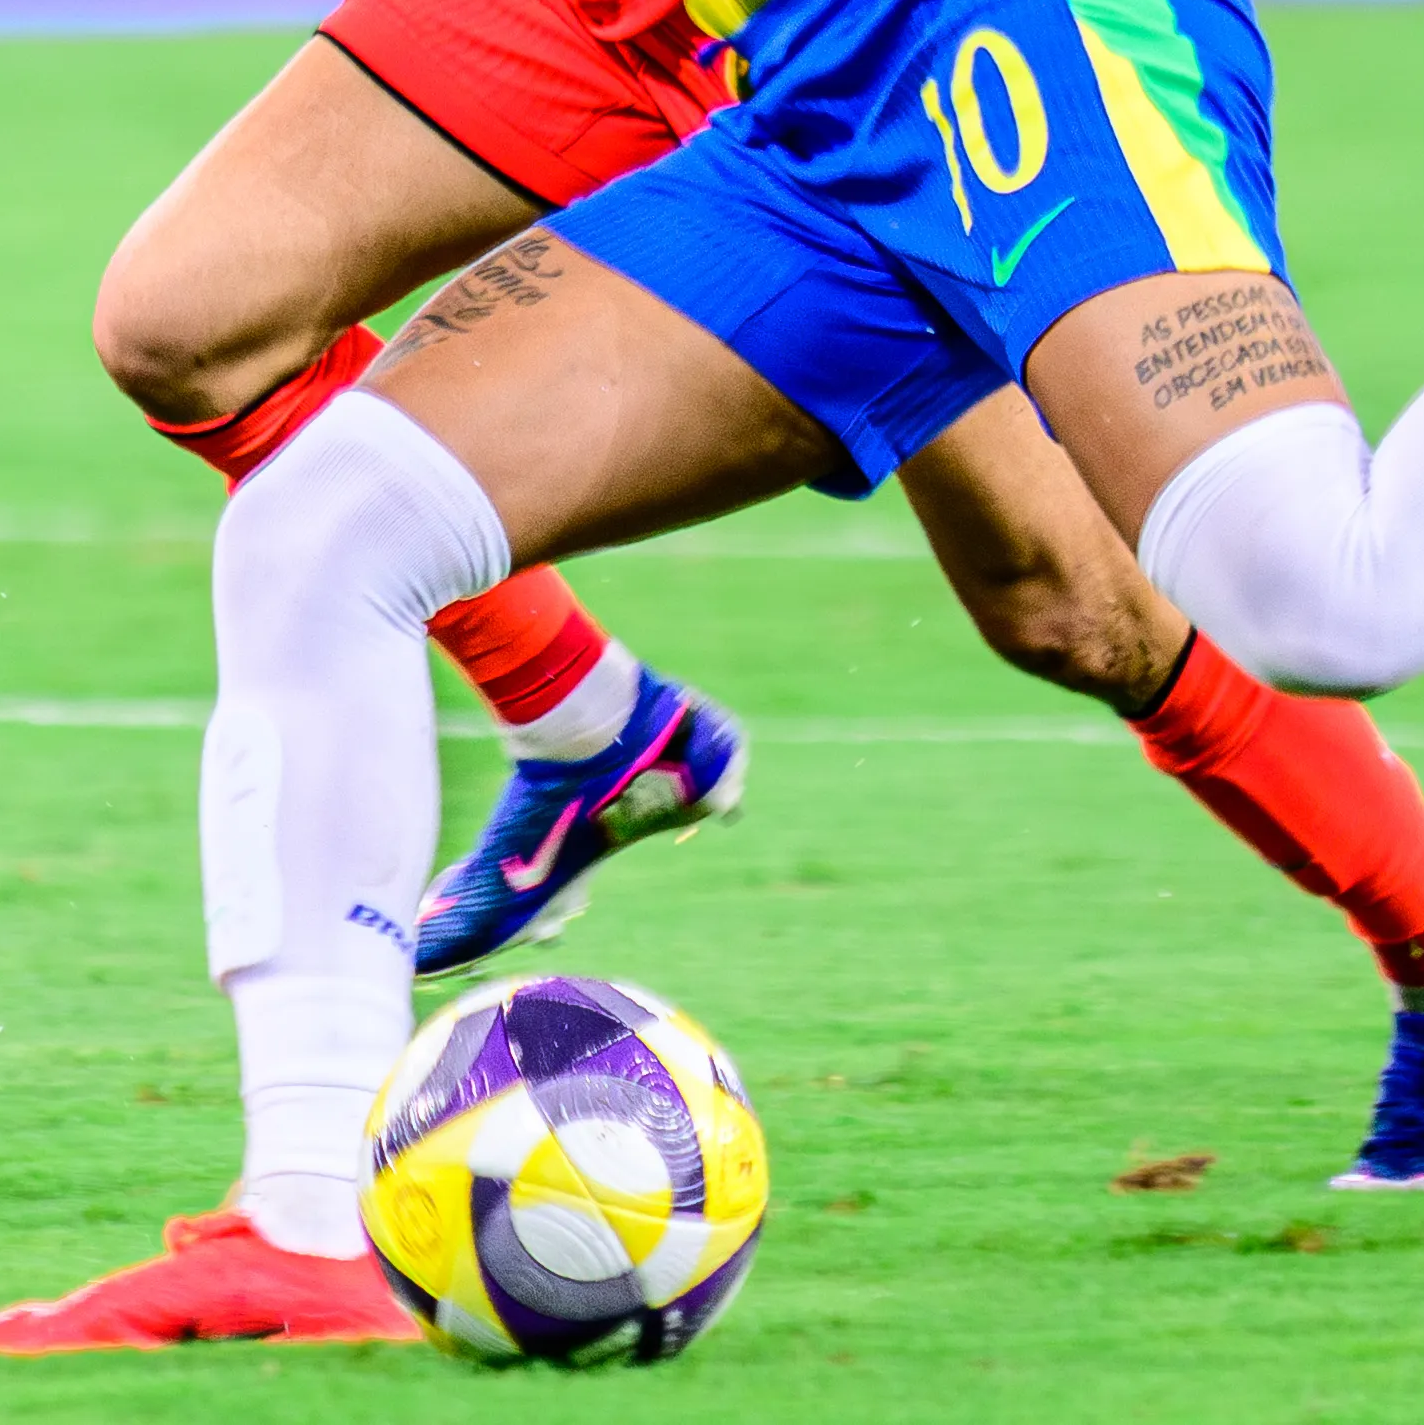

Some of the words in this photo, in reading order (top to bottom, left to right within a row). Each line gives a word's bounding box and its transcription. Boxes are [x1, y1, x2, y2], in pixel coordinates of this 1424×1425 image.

[921, 28, 1049, 237] 10
[1134, 311, 1273, 385] ENTENDEM
[1141, 314, 1173, 348] AS
[1209, 376, 1247, 411] EM
